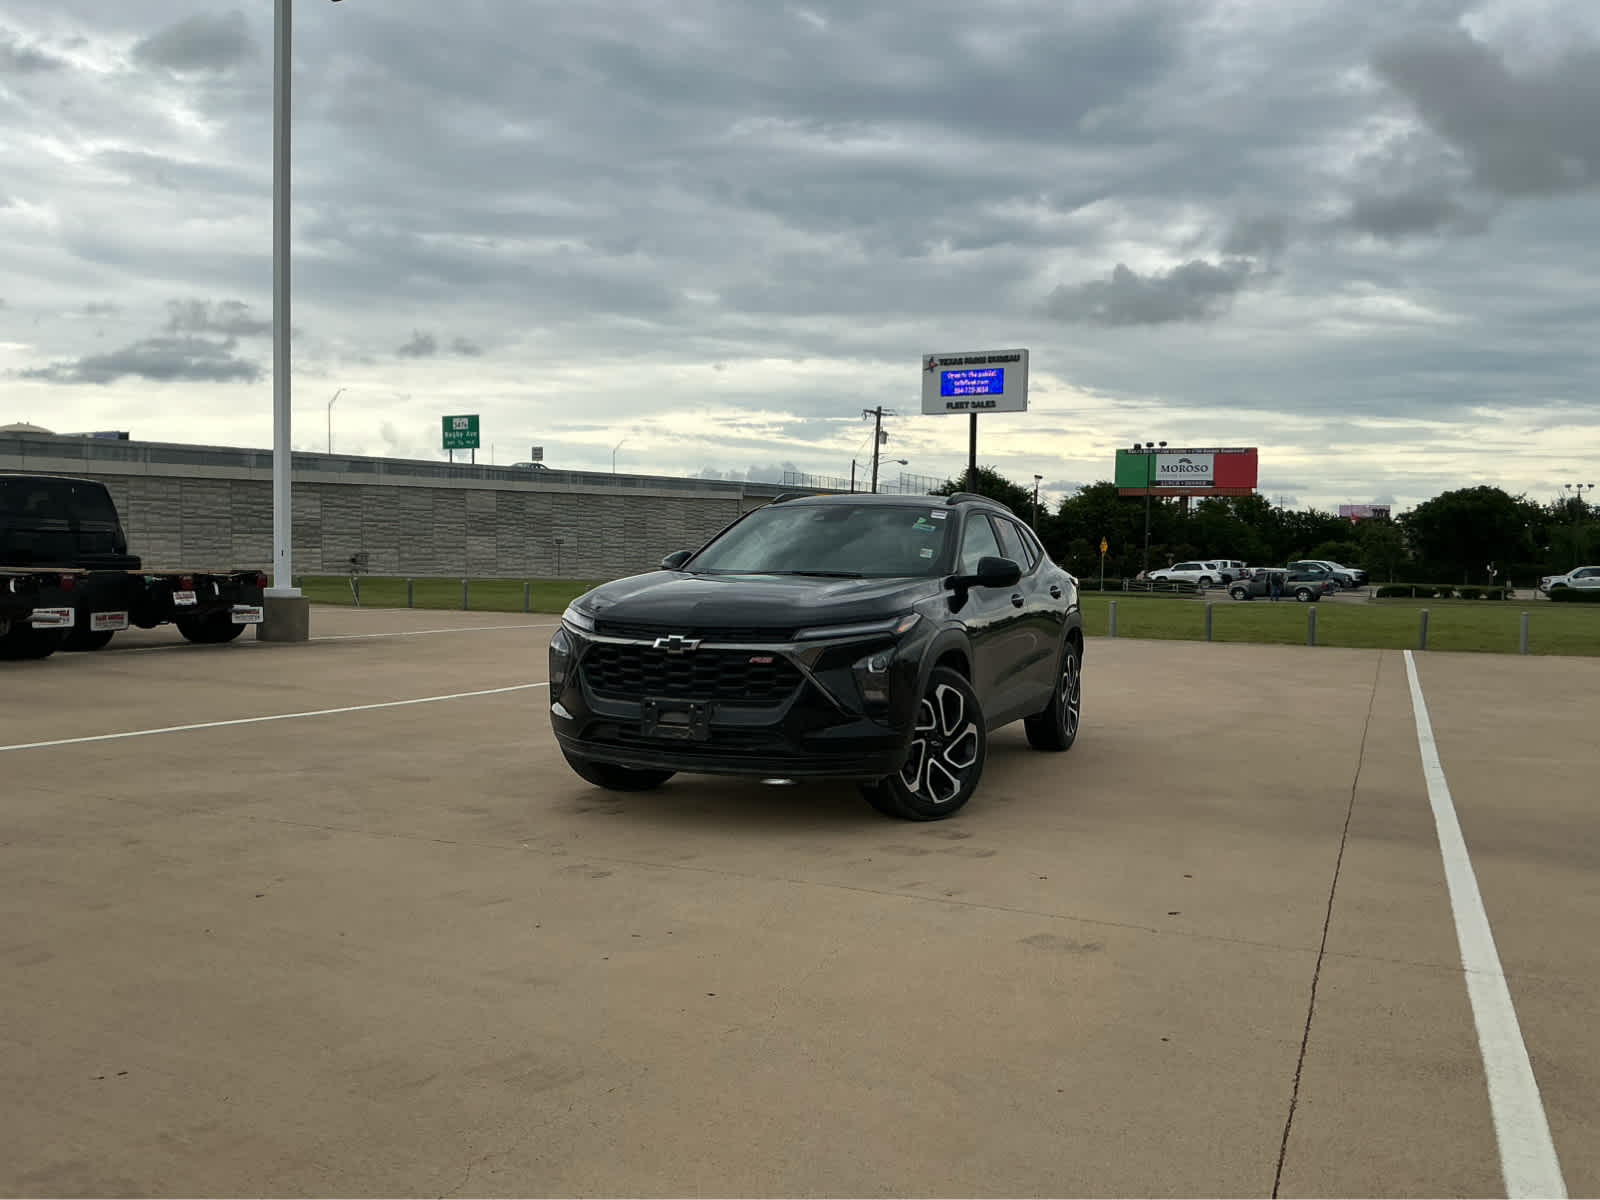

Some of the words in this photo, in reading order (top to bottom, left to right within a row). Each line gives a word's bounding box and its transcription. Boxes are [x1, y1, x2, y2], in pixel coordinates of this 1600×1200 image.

[946, 401, 970, 409] FLEET
[971, 400, 996, 408] SALES
[1160, 464, 1209, 473] MOROSO
